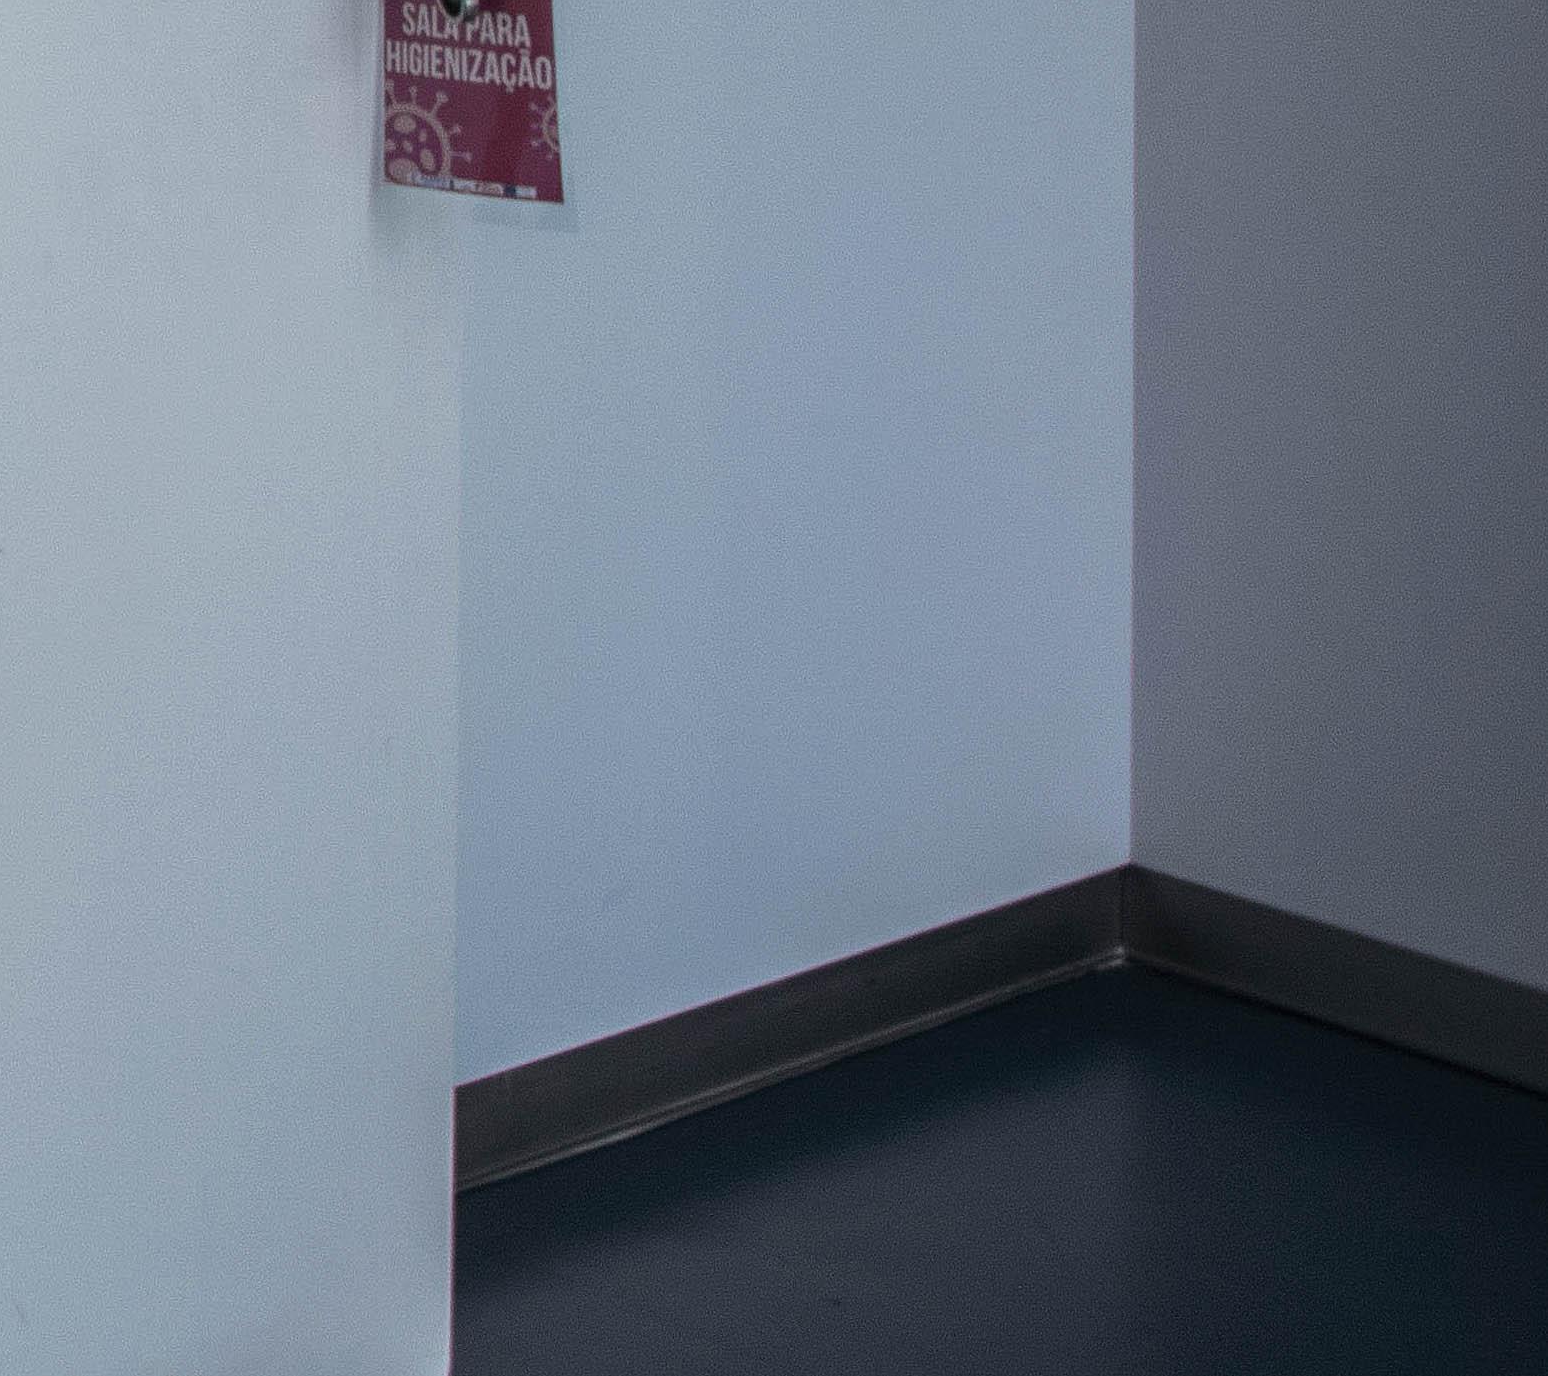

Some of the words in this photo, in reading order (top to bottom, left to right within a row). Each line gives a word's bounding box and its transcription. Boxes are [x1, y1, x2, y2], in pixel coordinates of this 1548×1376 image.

[402, 2, 459, 41] SALA
[465, 12, 531, 48] PARA
[386, 39, 553, 93] HIGIENIZAÇÃO
